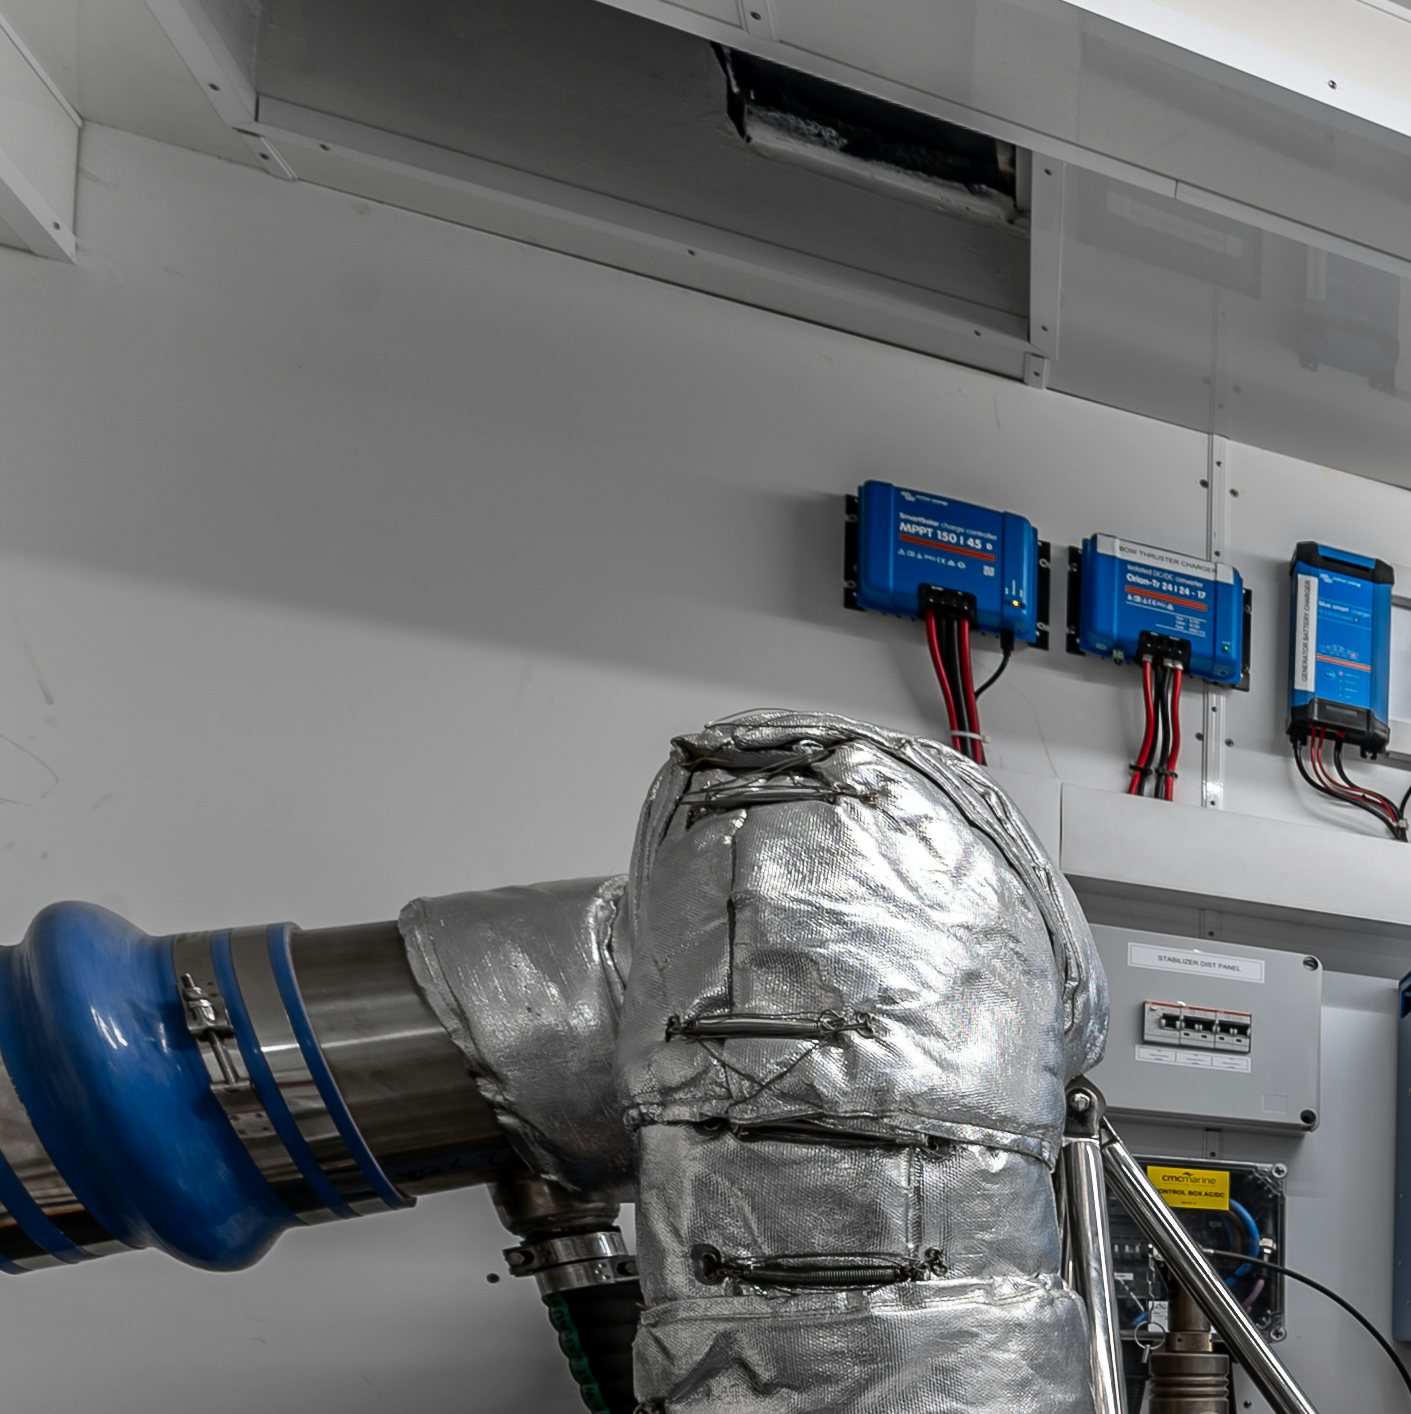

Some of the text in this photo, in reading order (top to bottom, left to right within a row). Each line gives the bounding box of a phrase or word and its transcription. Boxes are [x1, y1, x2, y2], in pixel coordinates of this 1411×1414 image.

[899, 522, 932, 538] MPPT
[937, 530, 957, 544] 150
[966, 537, 982, 549] 45
[1119, 545, 1217, 573] BOW THRUSTER CHARGER
[1126, 573, 1160, 588] Orion-Tr
[1161, 581, 1173, 592] 24
[1179, 584, 1190, 595] 24
[1302, 613, 1310, 641] BATTERY
[1301, 641, 1309, 682] GENERATOR
[1157, 955, 1241, 972] STABILIZER DIST PANEL
[1161, 1174, 1217, 1185] cmcmarine
[1203, 1191, 1225, 1199] AC/DC
